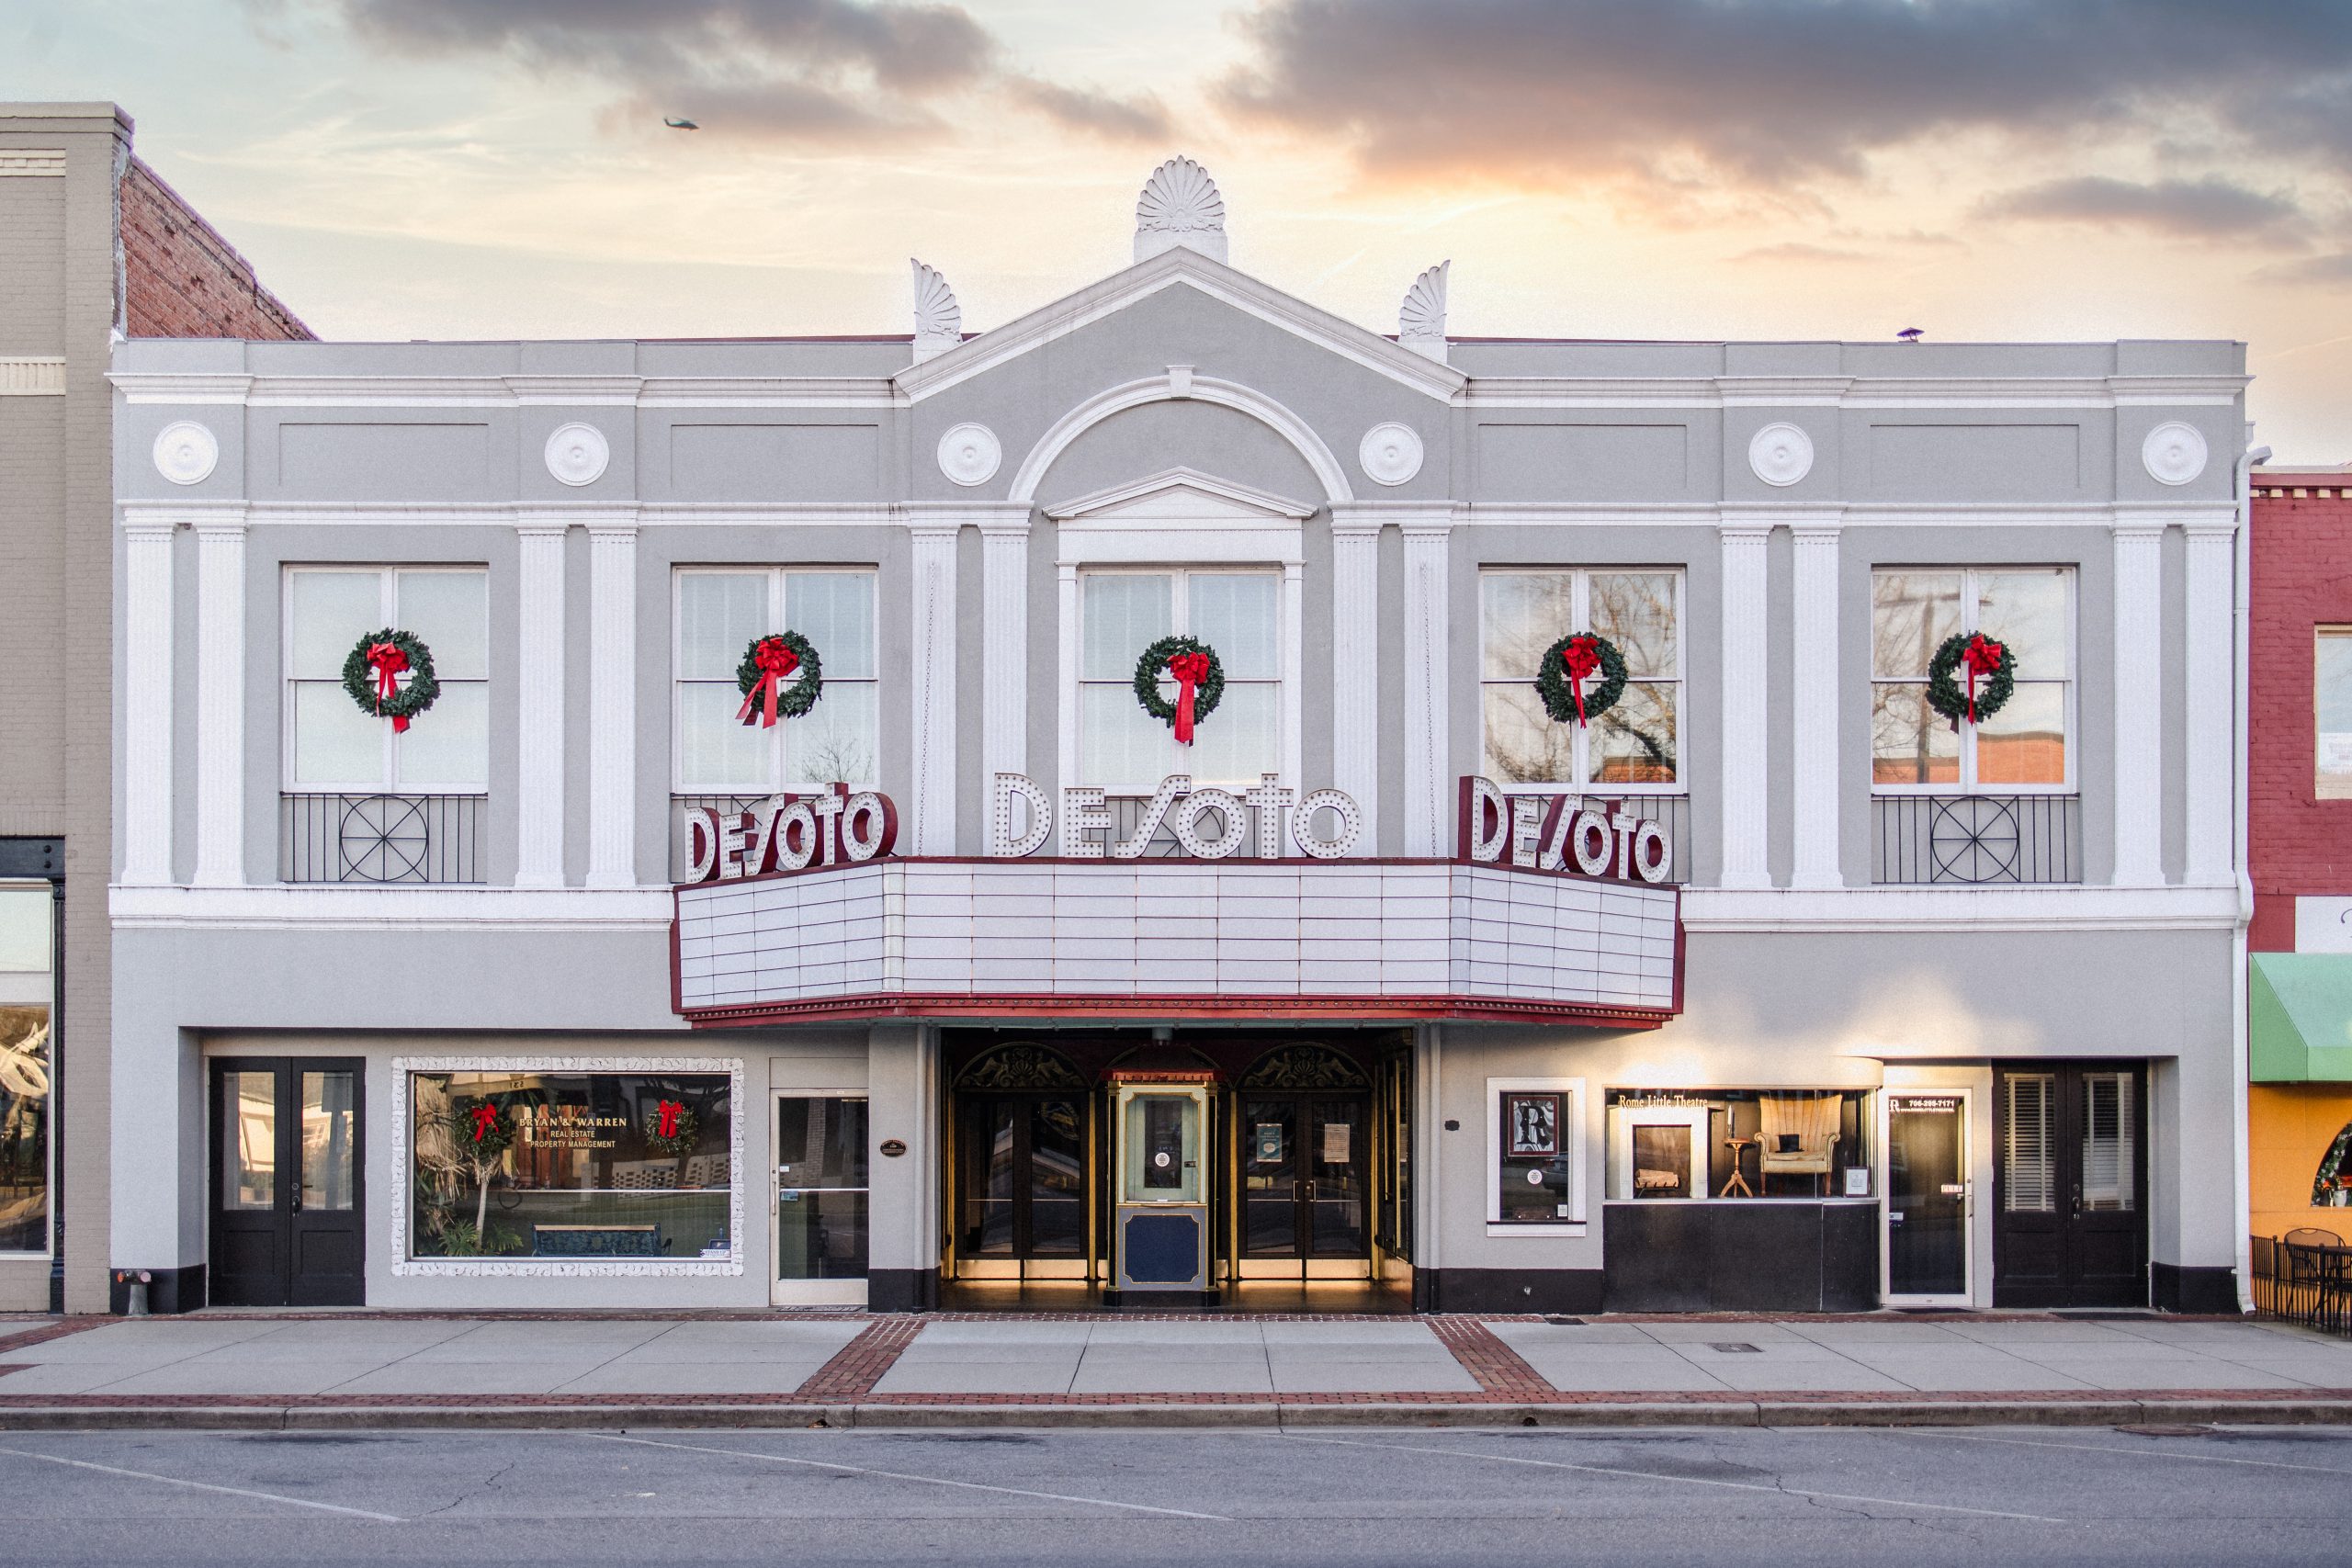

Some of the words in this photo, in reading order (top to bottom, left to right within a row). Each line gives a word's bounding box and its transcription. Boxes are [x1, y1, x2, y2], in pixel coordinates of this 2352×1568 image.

[1619, 1095, 1645, 1108] Rome
[1647, 1094, 1671, 1108] Little
[1673, 1094, 1708, 1108] Theatre
[519, 1118, 558, 1127] BRYAN
[561, 1118, 571, 1126] &
[576, 1118, 627, 1127] WARREN
[550, 1130, 569, 1138] REAL
[571, 1130, 595, 1138] ESTATE
[530, 1140, 566, 1148] PROPERTY
[568, 1140, 616, 1148] MANAGEMENT
